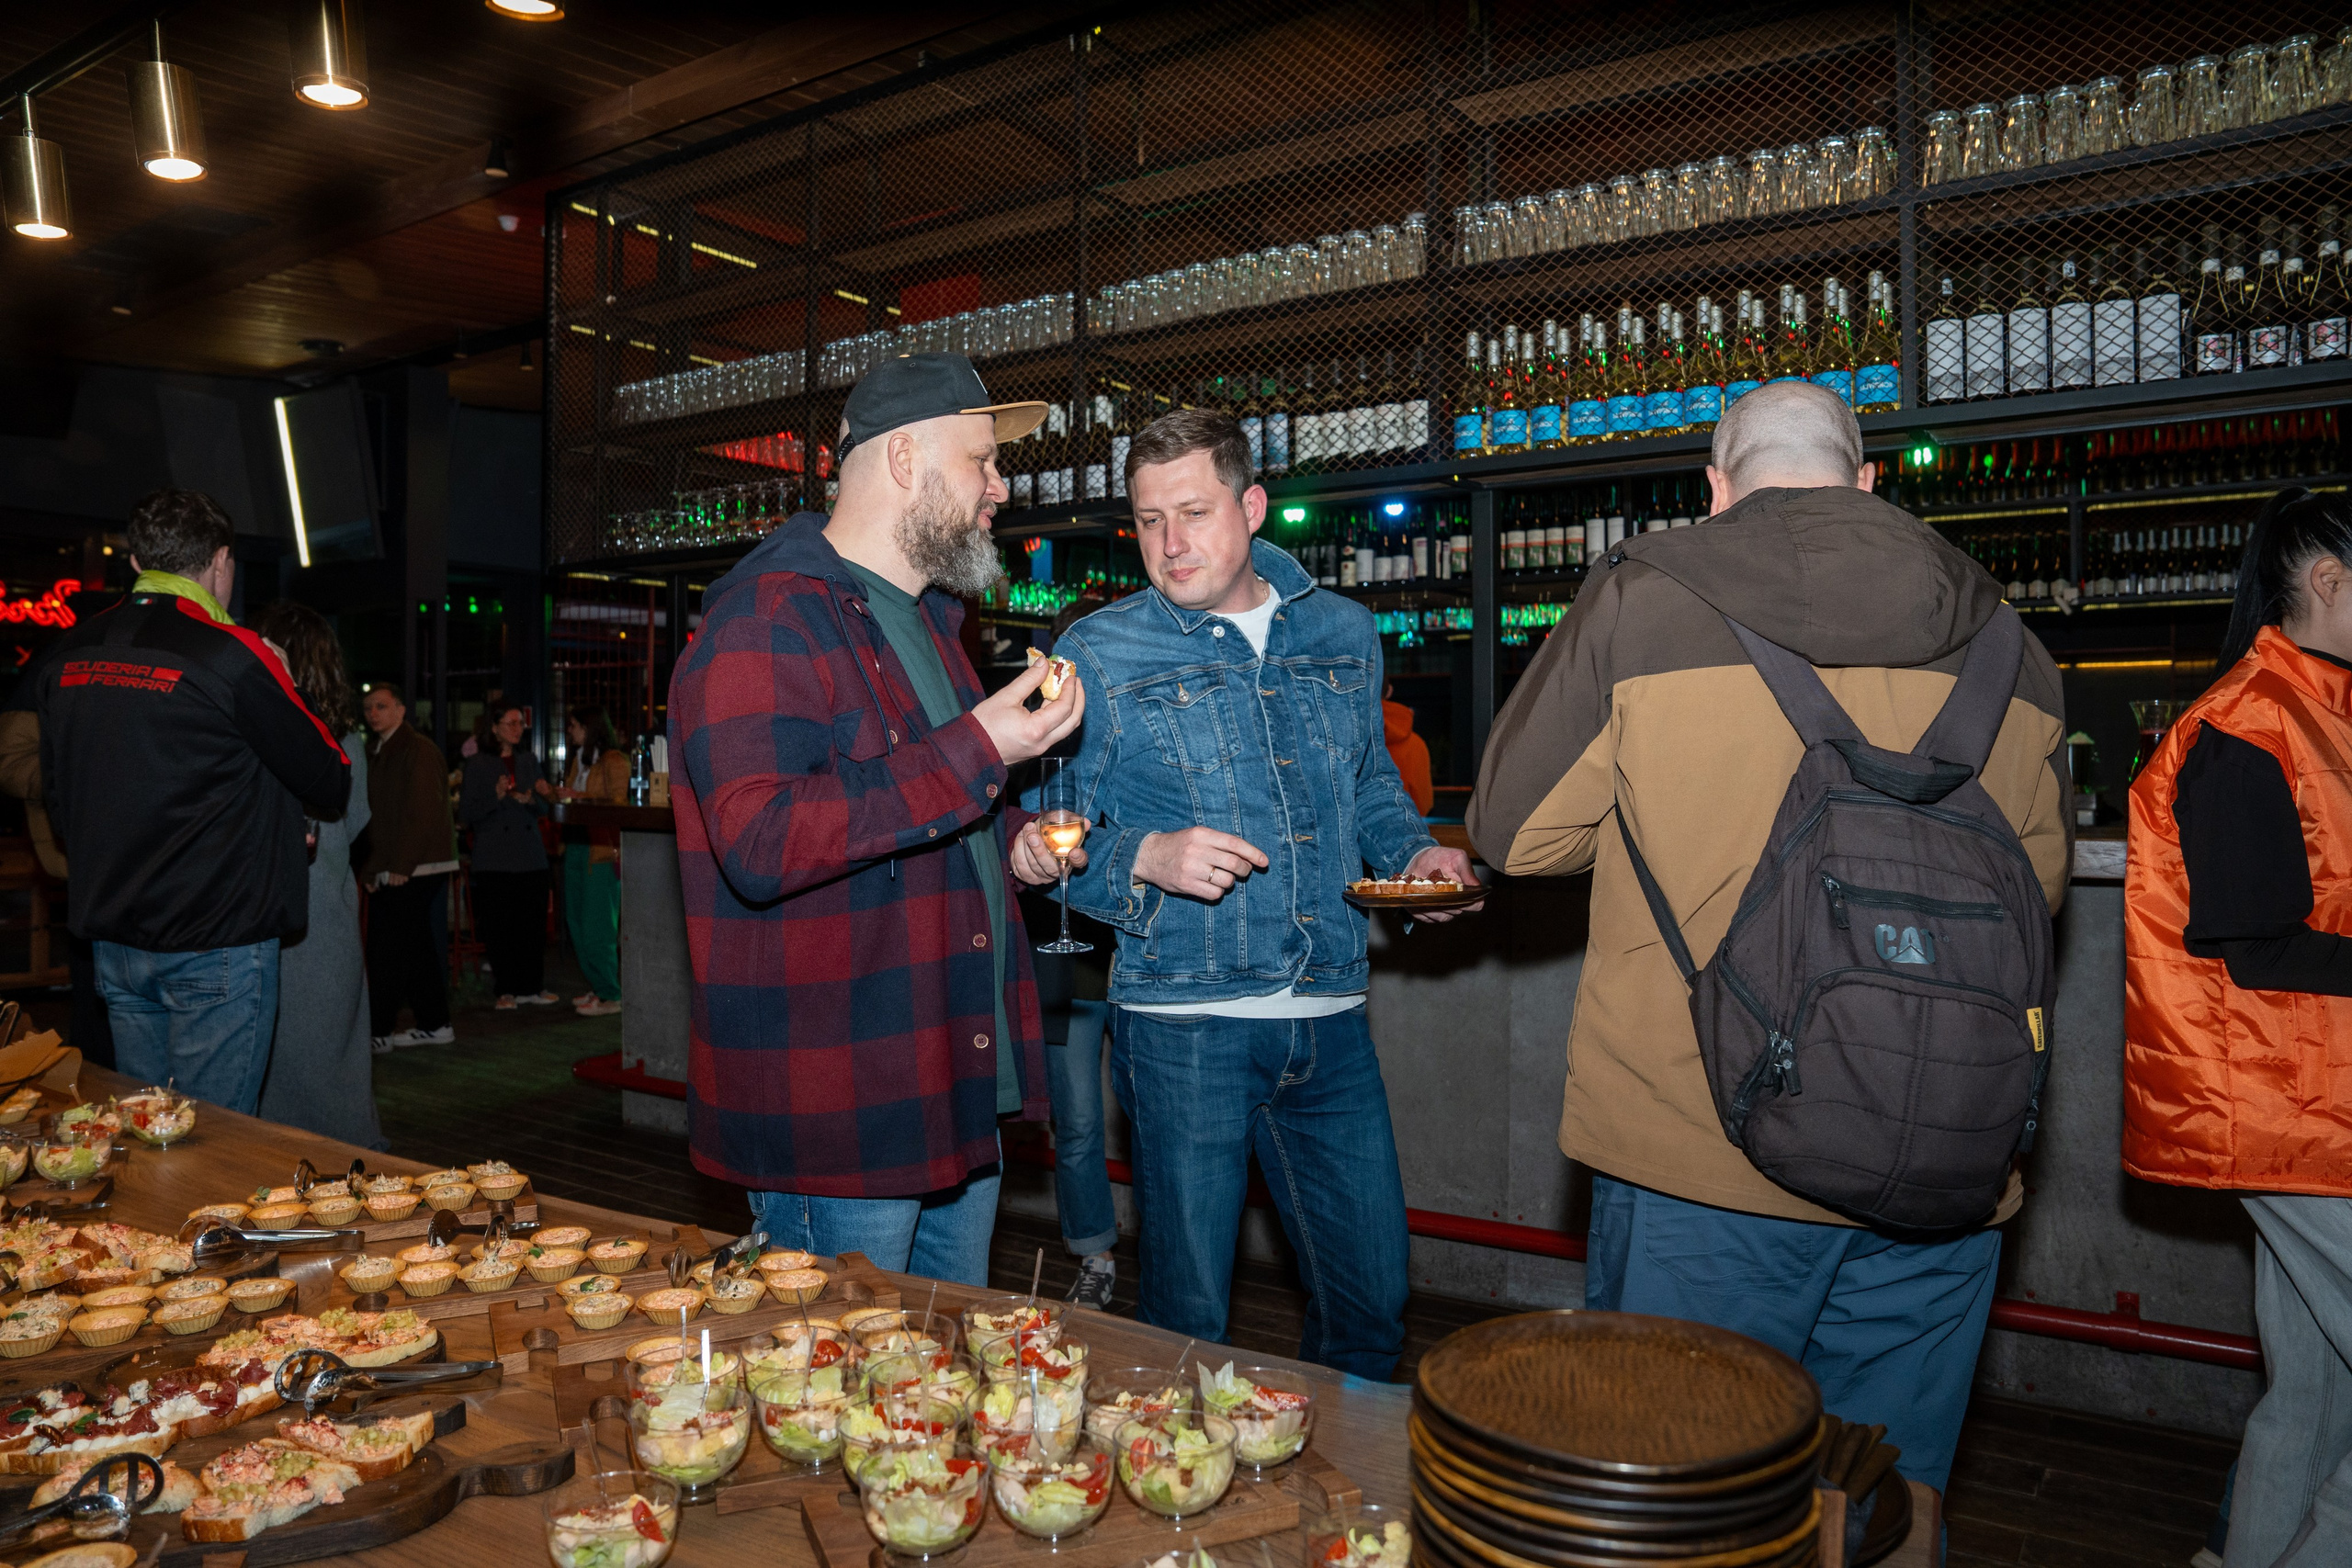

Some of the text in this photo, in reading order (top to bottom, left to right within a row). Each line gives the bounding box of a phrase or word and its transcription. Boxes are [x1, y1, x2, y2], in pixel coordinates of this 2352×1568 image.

[62, 660, 153, 677] SCUDERIA
[89, 673, 175, 694] FERRARI
[1874, 923, 1936, 964] CAT
[2033, 1010, 2043, 1048] CATERPILLAR
